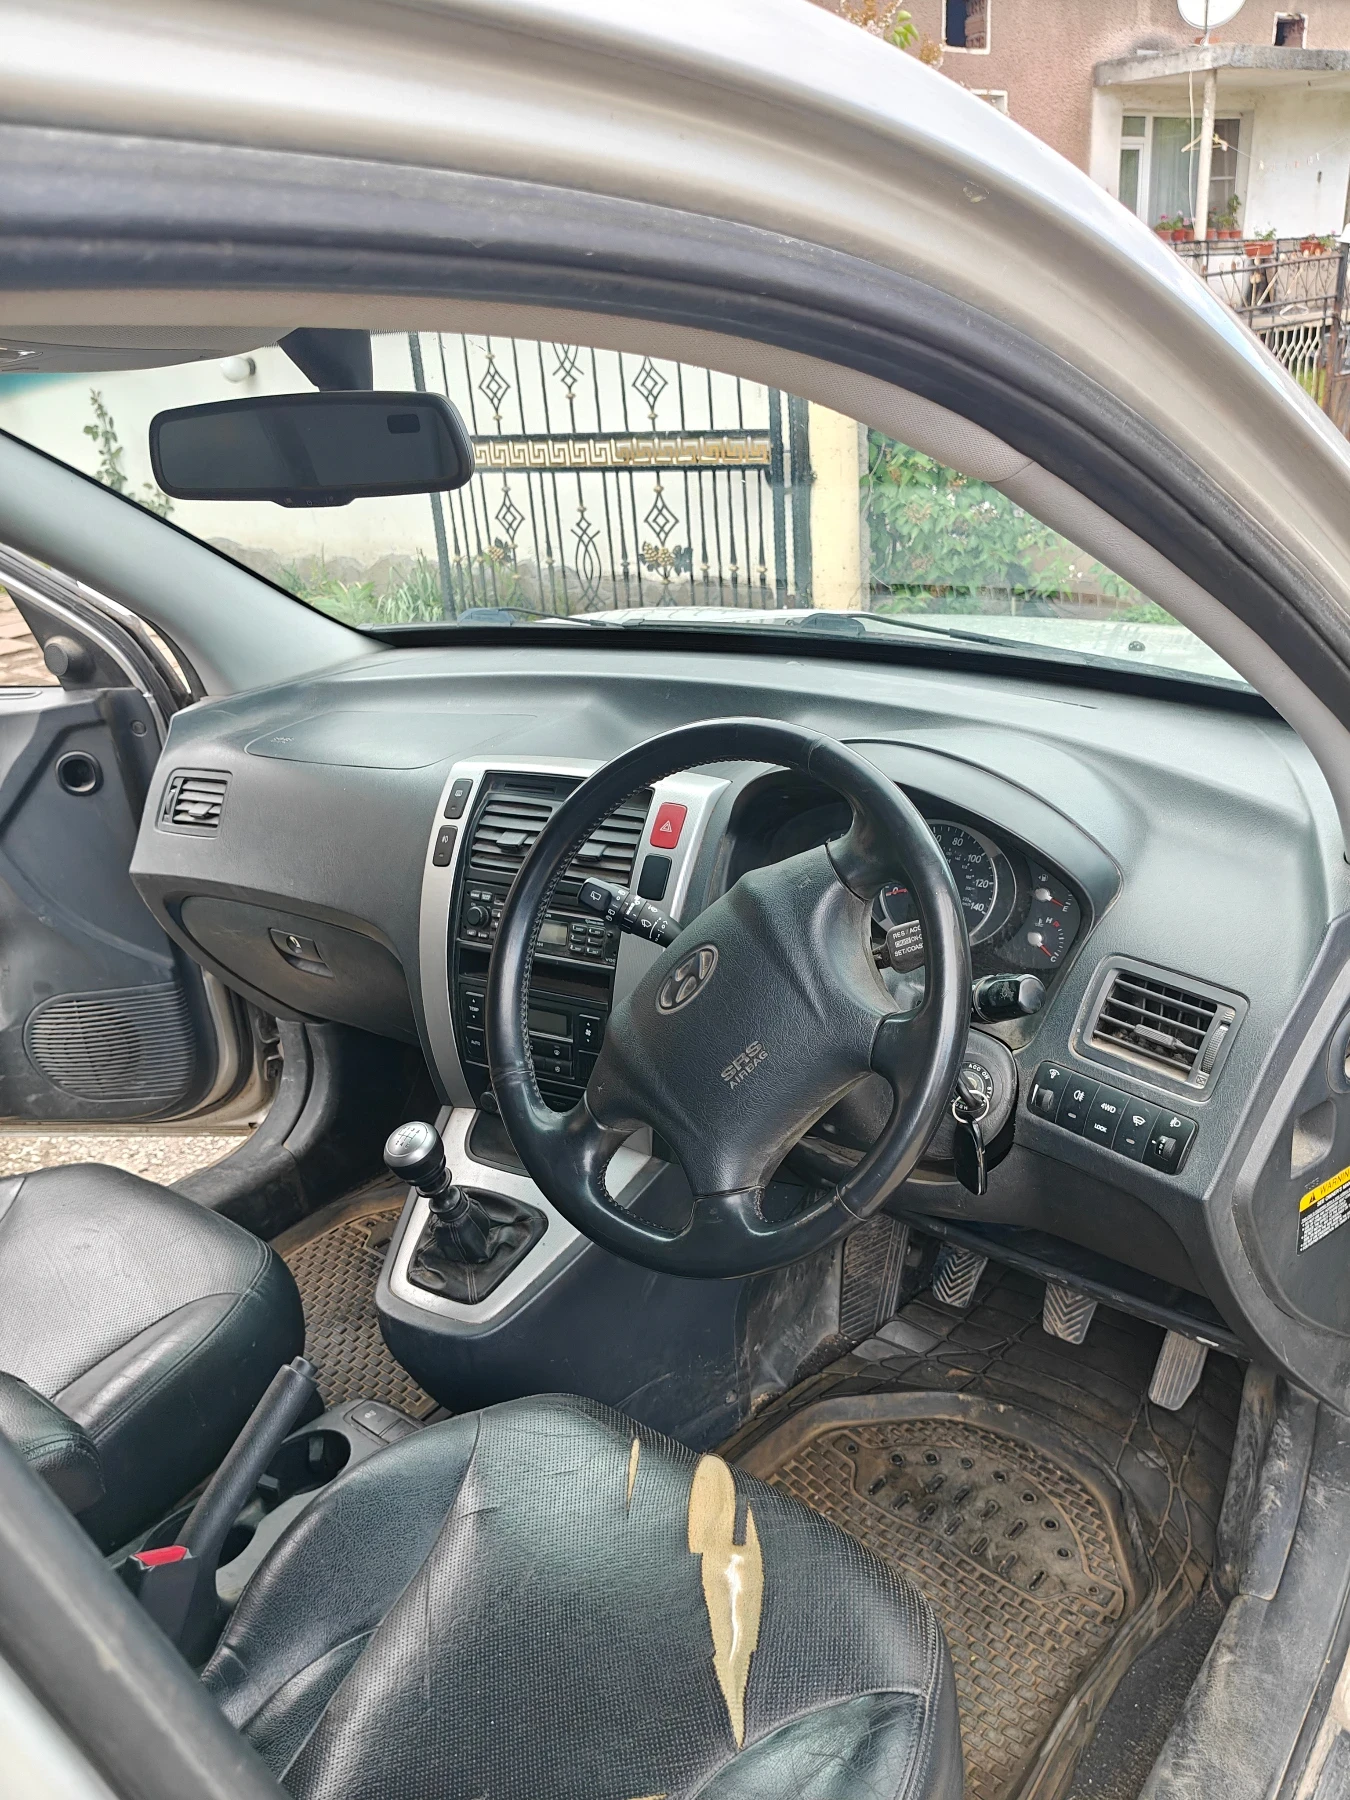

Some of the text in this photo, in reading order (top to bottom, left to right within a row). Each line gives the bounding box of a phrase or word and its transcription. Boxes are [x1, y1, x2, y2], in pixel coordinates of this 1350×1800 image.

[952, 837, 963, 846] 80
[968, 854, 982, 864] 100
[975, 879, 989, 888] 120
[970, 902, 985, 912] 140
[892, 930, 906, 940] RES
[894, 942, 924, 957] SET/COAS
[1050, 954, 1057, 962] C
[720, 1040, 763, 1082] SRS
[730, 1050, 769, 1090] AIRBAG
[968, 1063, 981, 1072] ACC
[981, 1071, 990, 1080] ON
[1100, 1102, 1116, 1114] 4WD
[1094, 1123, 1108, 1133] LOCK
[1320, 1169, 1350, 1195] WARNIN
